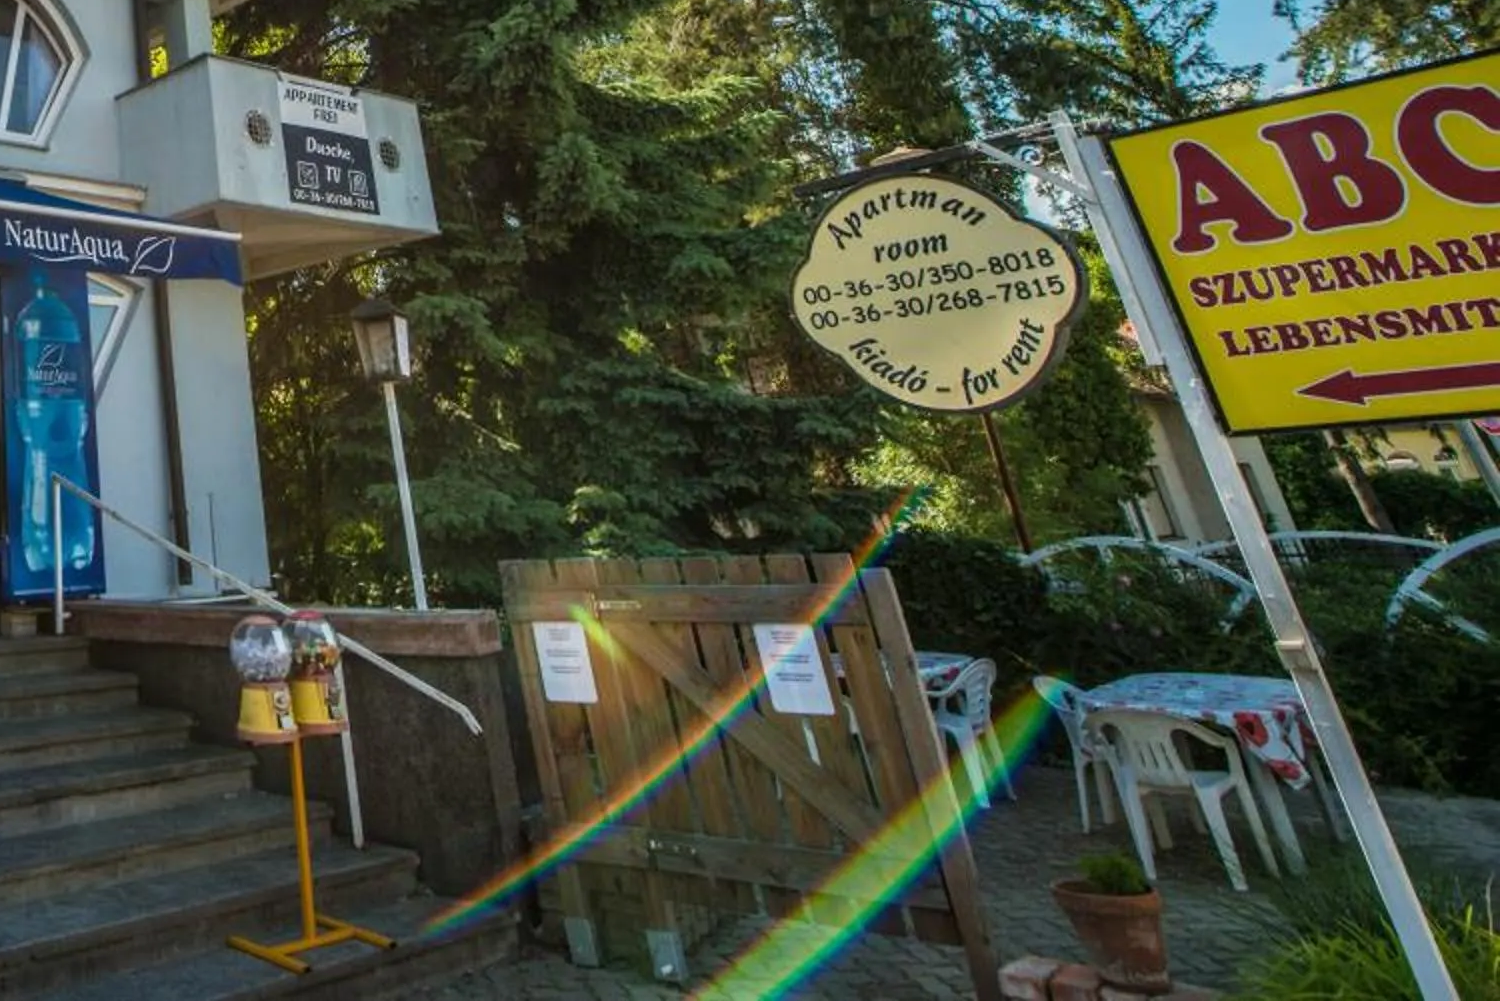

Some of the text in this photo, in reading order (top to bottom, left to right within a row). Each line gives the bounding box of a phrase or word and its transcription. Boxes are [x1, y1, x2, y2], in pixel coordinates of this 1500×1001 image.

[325, 165, 341, 184] TV
[1169, 84, 1500, 255] ABC
[4, 218, 125, 264] NaturAqua
[827, 187, 987, 250] Apartman
[873, 232, 949, 263] room
[803, 248, 1055, 305] 00-36-30/350-8018
[1188, 232, 1500, 309] SZUPERMARK
[810, 274, 1065, 330] 00-36-30/268-7815
[1219, 298, 1500, 358] LEBENSMIT
[848, 337, 929, 394] kiadó
[960, 366, 1000, 405] for
[1002, 316, 1045, 376] rent
